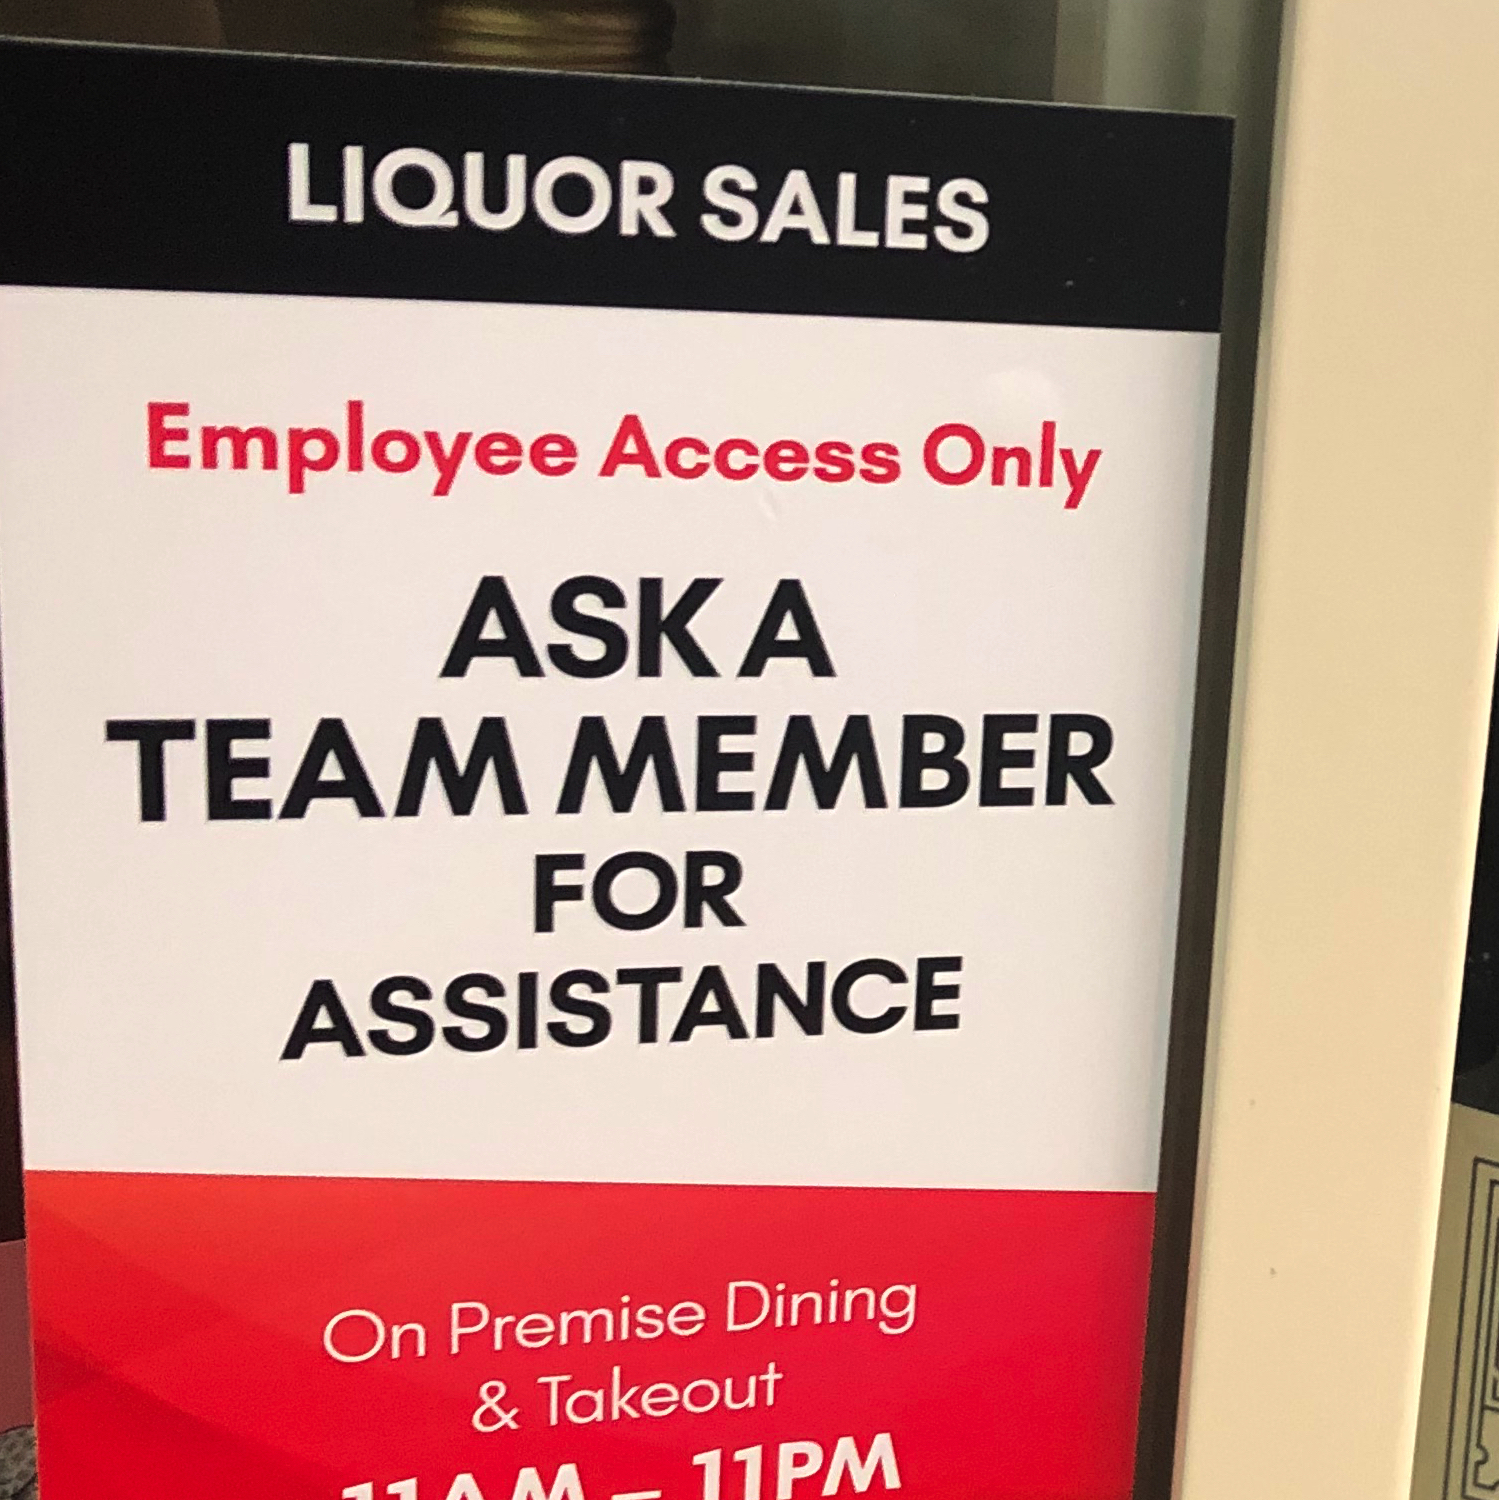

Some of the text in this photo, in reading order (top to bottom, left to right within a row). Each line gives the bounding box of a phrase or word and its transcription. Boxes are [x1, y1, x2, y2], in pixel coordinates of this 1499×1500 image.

[287, 143, 991, 254] LIQUOR SALES
[146, 400, 1102, 509] Employee Access Only
[440, 576, 835, 680] ASK A
[106, 713, 1116, 823] TEAM MEMBER
[533, 851, 746, 934] FOR
[280, 957, 963, 1062] ASSISTANCE
[321, 1276, 919, 1366] On Premise Dining
[470, 1362, 784, 1434] & Takeout
